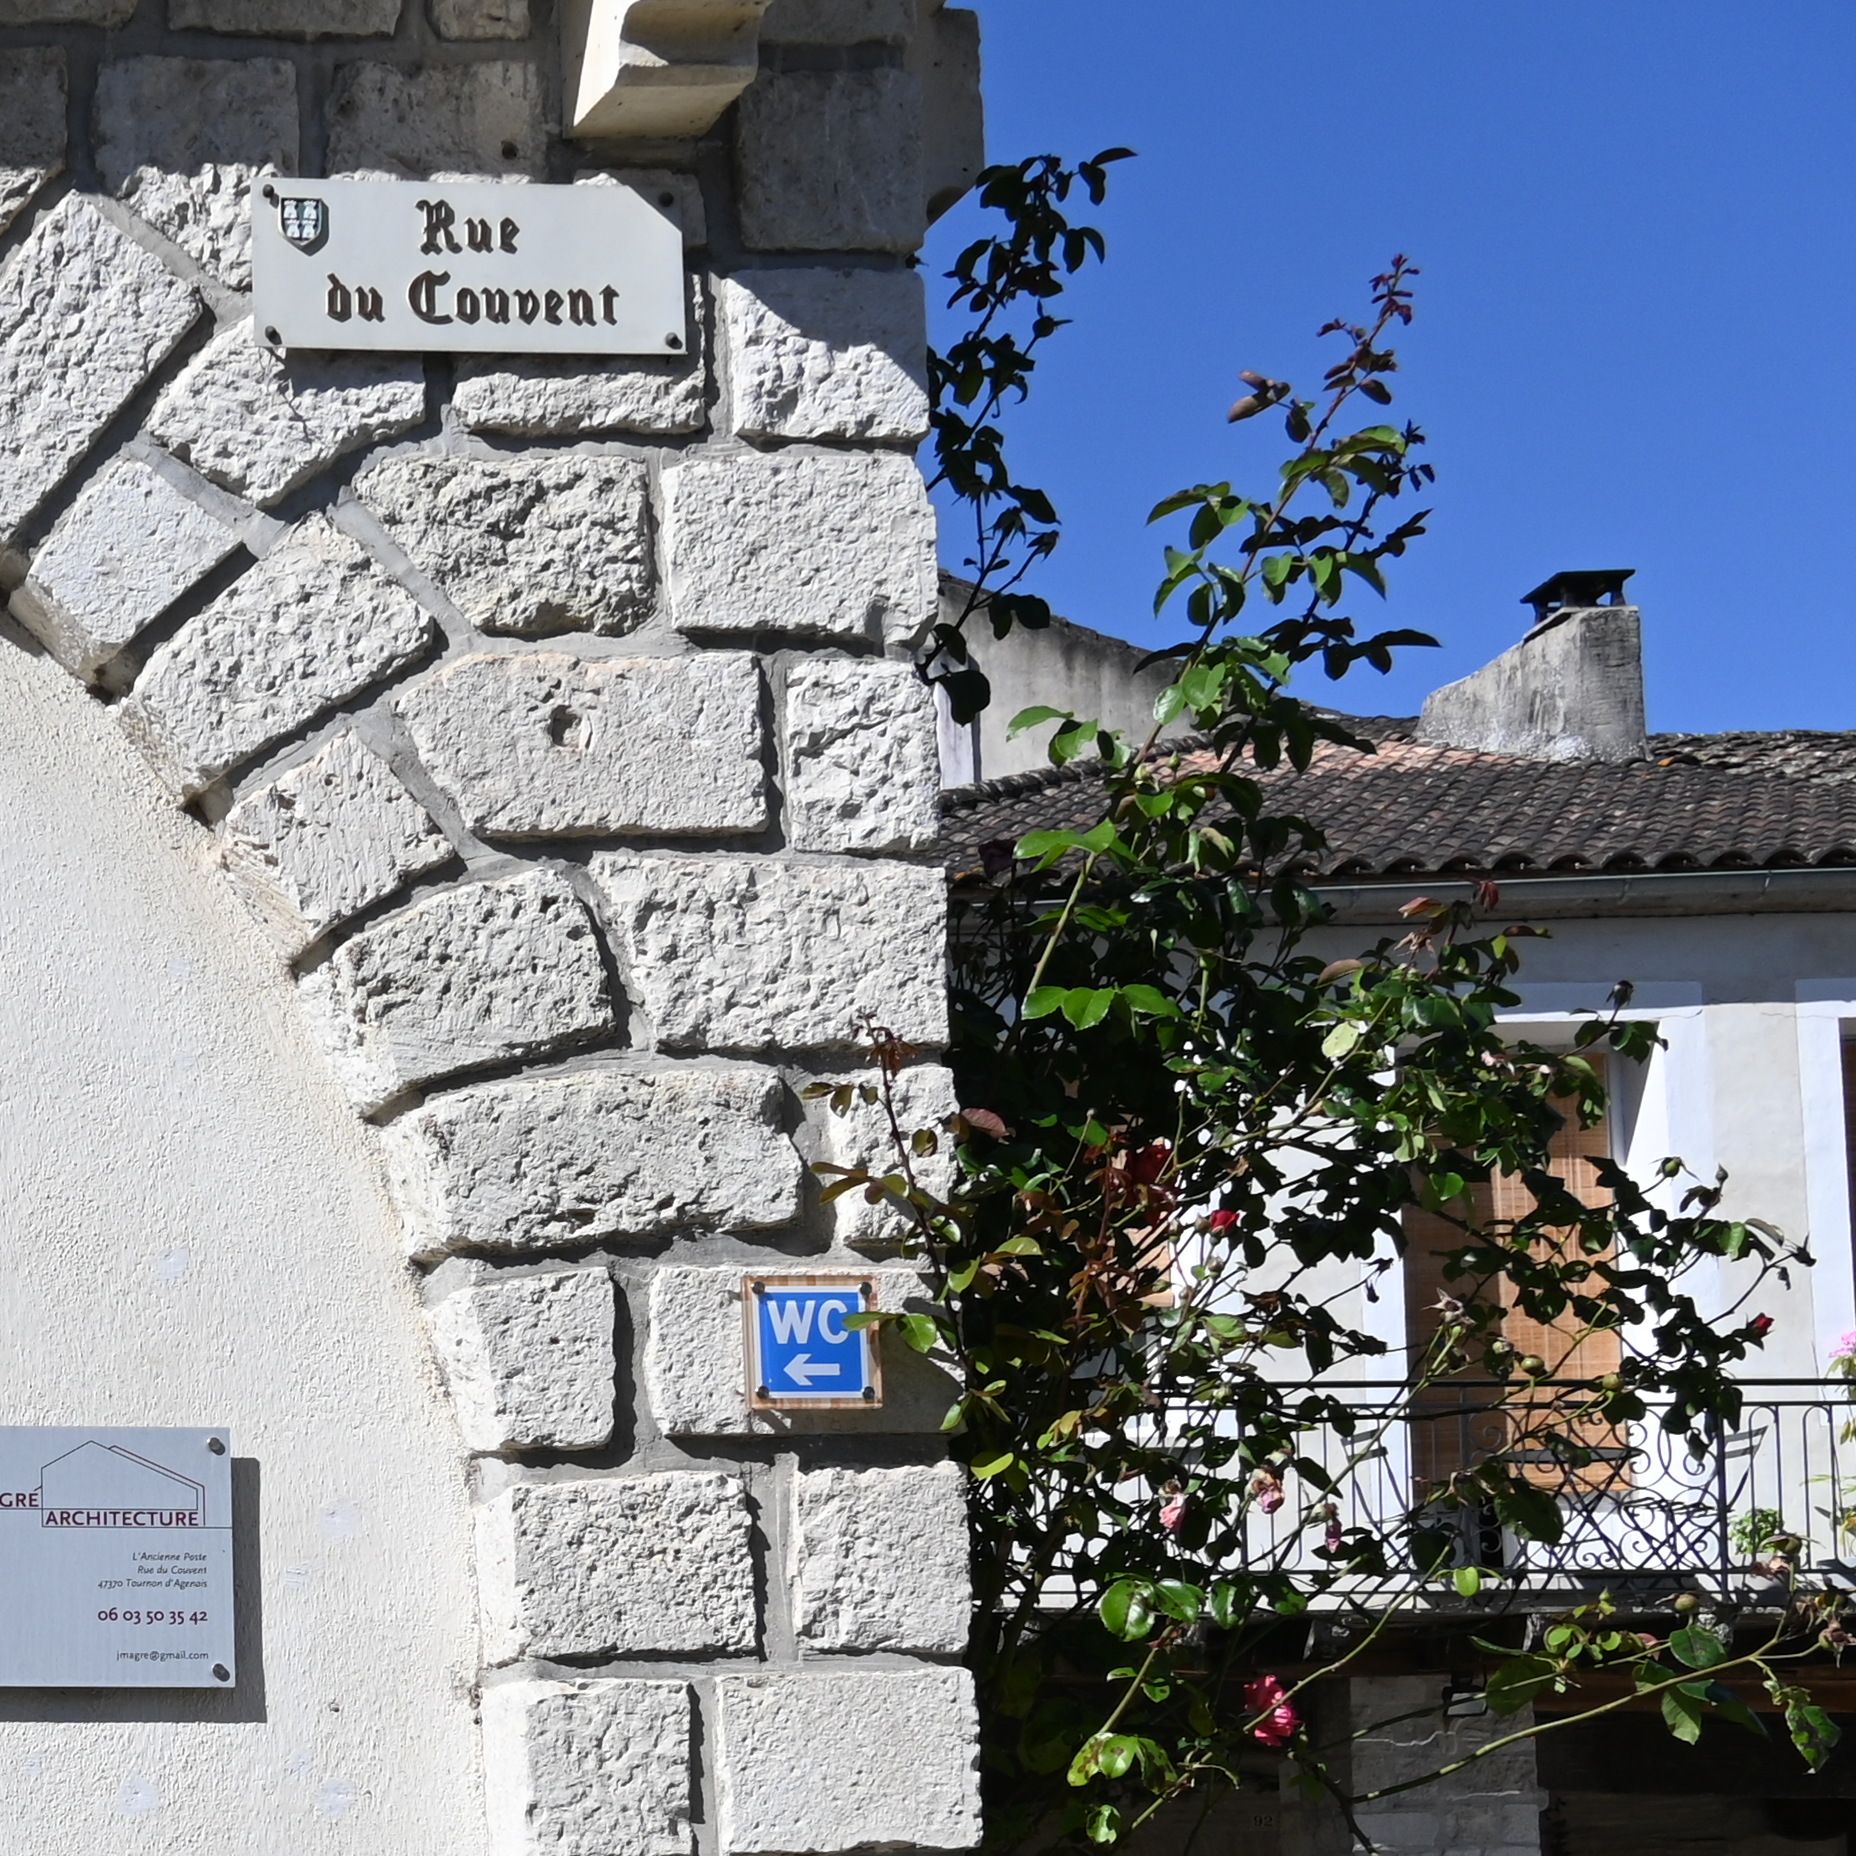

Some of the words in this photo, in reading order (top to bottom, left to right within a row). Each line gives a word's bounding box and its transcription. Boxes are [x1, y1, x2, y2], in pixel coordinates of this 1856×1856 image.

[416, 199, 520, 256] Rue
[326, 272, 386, 323] du
[407, 270, 620, 326] Couvent
[767, 1299, 849, 1345] WC
[45, 1510, 199, 1527] ARCHITECTURE
[132, 1552, 181, 1561] L'Ancienne
[184, 1552, 207, 1561] Poste
[137, 1565, 155, 1575] Rue
[156, 1565, 168, 1575] du
[97, 1580, 124, 1590] 47370
[126, 1579, 163, 1588] Tournon
[97, 1607, 118, 1621] 06
[122, 1610, 141, 1625] 03
[146, 1610, 164, 1625] 50
[169, 1610, 185, 1625] 35
[189, 1611, 208, 1625] 42
[116, 1650, 209, 1662] jmagre@gmail.com
[1254, 1815, 1273, 1827] 92
